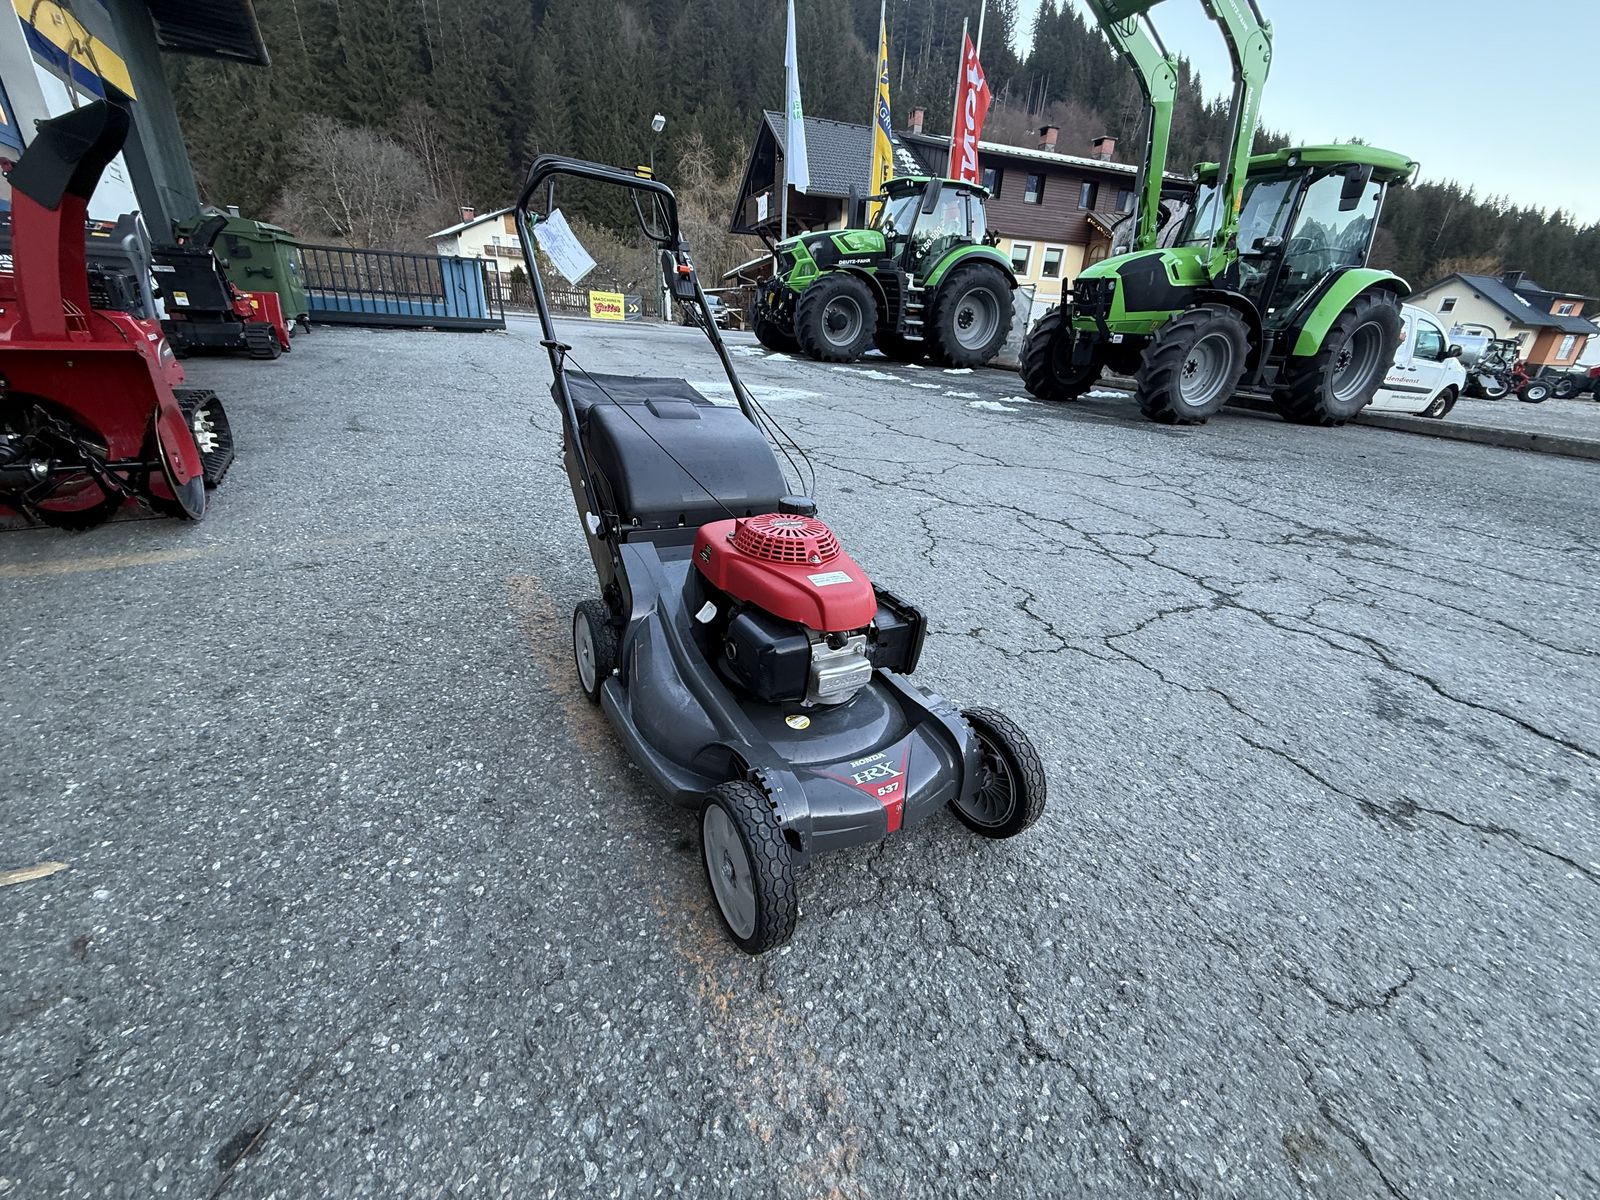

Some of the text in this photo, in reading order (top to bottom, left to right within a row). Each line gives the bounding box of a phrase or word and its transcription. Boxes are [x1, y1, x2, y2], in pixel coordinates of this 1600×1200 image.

[850, 752, 887, 768] HONDA
[850, 760, 904, 785] HRX
[877, 782, 899, 796] 537
